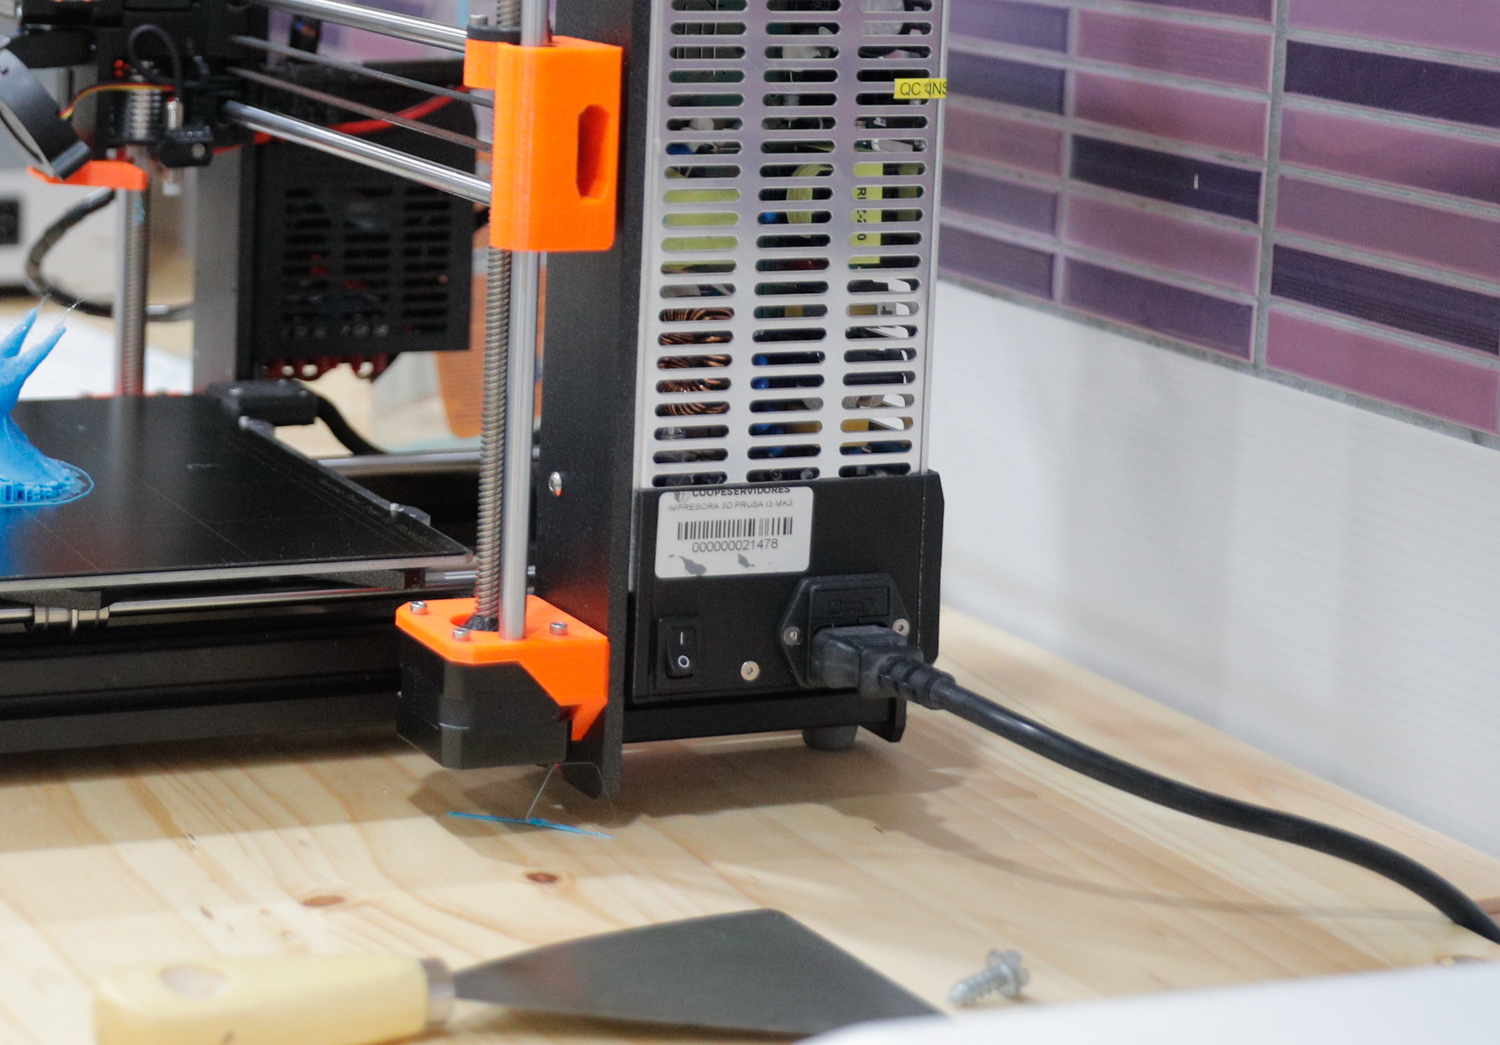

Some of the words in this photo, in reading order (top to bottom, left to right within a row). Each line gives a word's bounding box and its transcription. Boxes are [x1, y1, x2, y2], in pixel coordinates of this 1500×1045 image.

[900, 82, 921, 96] QC
[692, 487, 791, 497] COOPESERVIDORES
[668, 503, 719, 512] IMPRESORA
[721, 502, 733, 510] 3D
[734, 500, 764, 509] PRUSA
[692, 538, 778, 553] 000000021478
